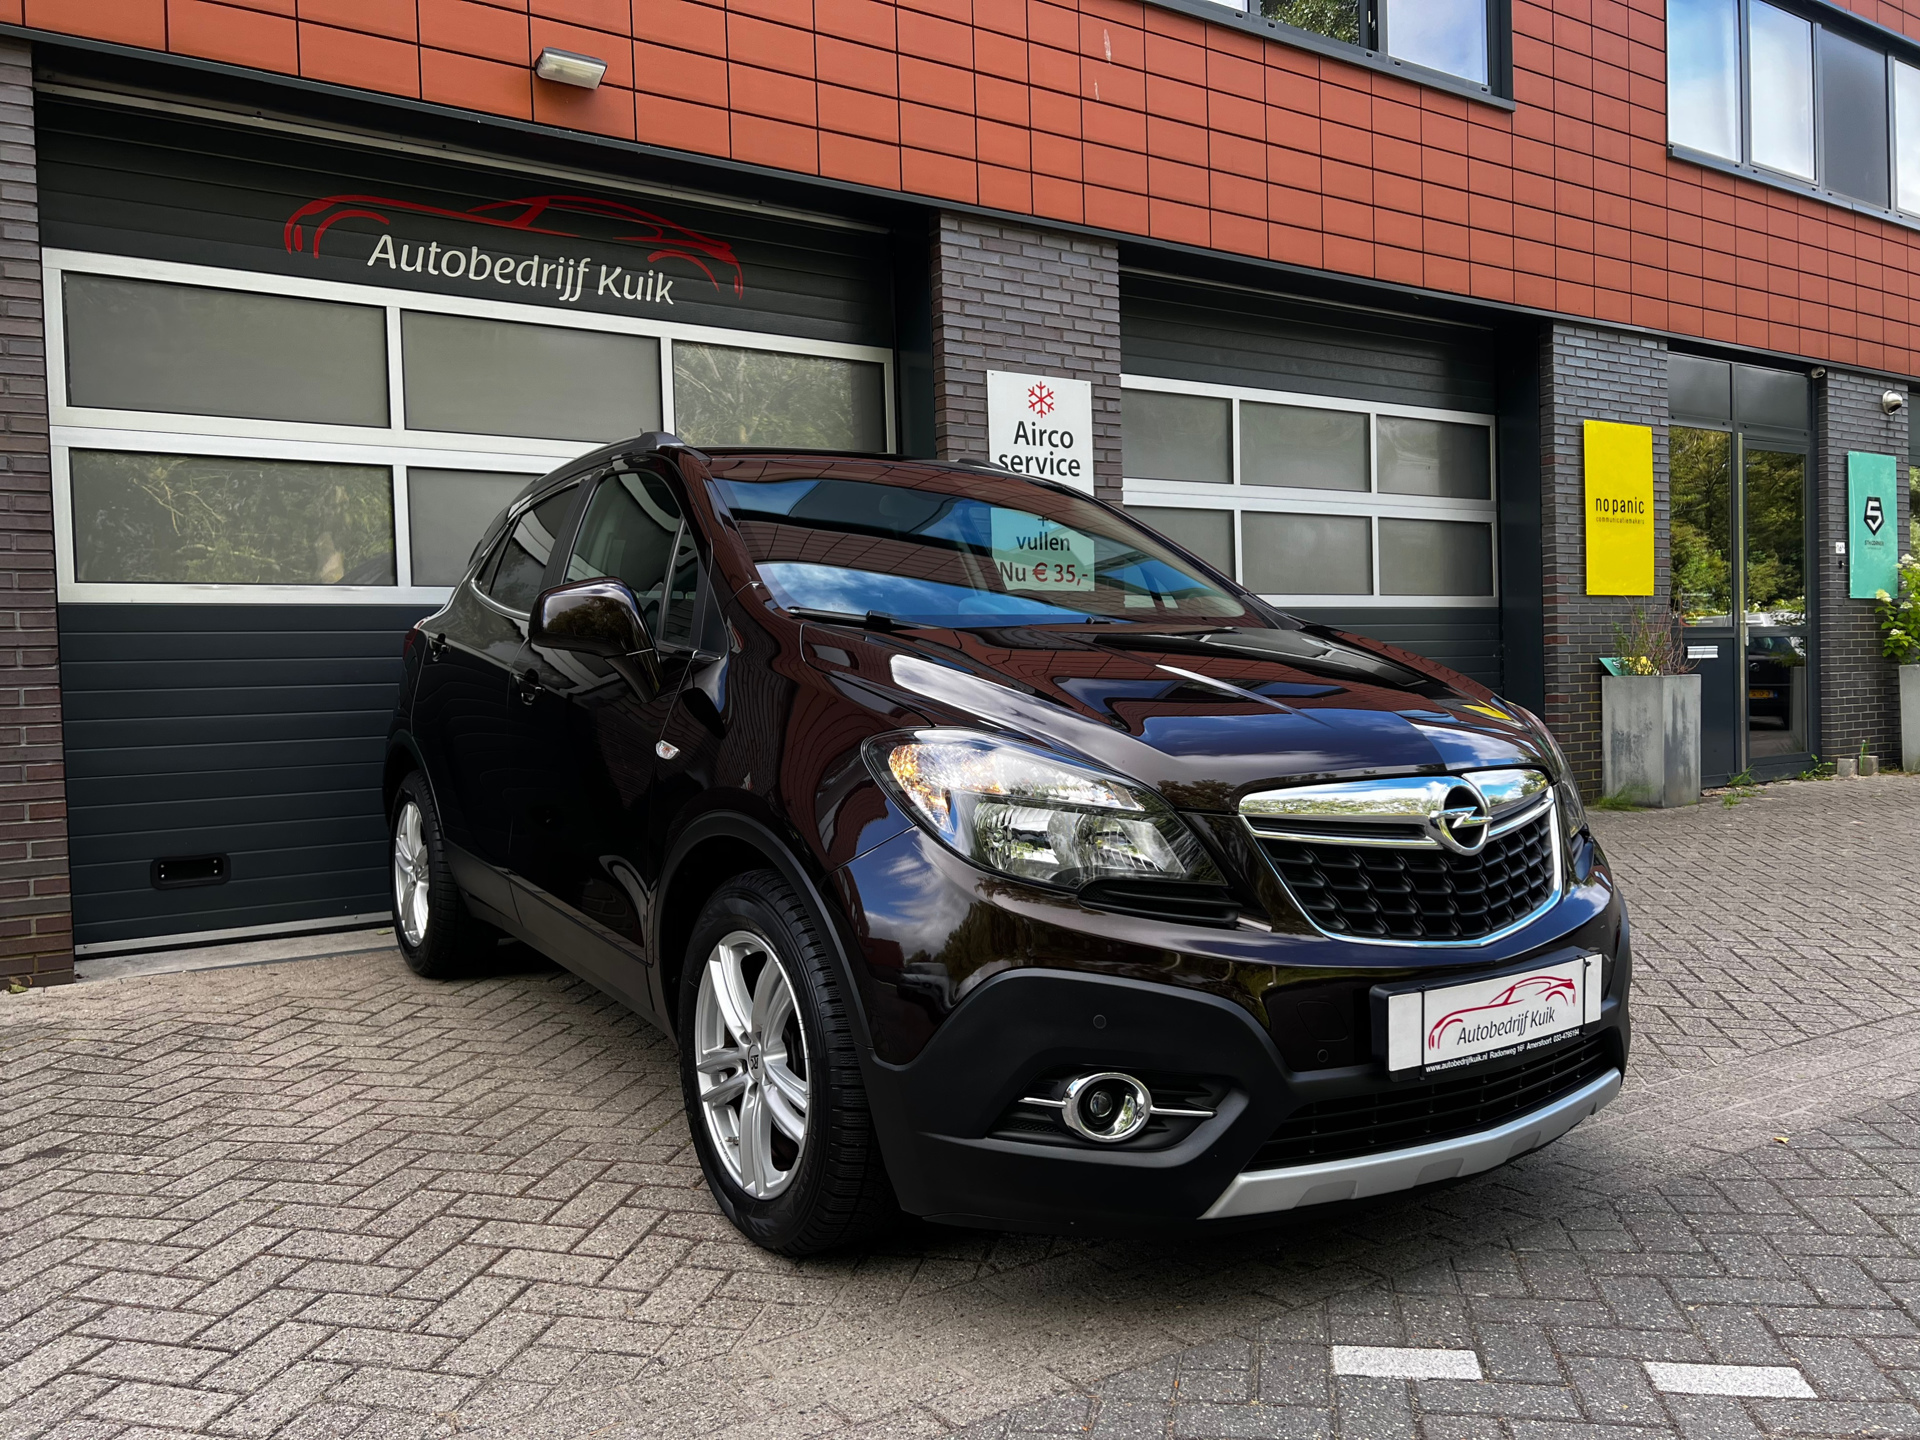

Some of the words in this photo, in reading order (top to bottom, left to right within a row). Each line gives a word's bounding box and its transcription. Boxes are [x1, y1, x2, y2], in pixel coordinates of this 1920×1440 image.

[367, 234, 592, 303] Autobedrijf
[598, 263, 675, 306] Kuik
[1013, 420, 1075, 449] Airco
[998, 451, 1081, 478] service
[1596, 497, 1610, 512] no
[1612, 496, 1645, 516] panic
[1016, 531, 1071, 551] vullen
[999, 561, 1027, 582] Nu
[1032, 562, 1048, 583] €
[1054, 563, 1089, 586] 35,-
[1457, 1011, 1529, 1045] Autobedrijf
[1530, 1007, 1556, 1028] Kuik
[1425, 1053, 1488, 1073] www.autobedrijfkuik.nl
[1489, 1043, 1517, 1060] Radonweg
[1526, 1037, 1553, 1050] Amersfoort
